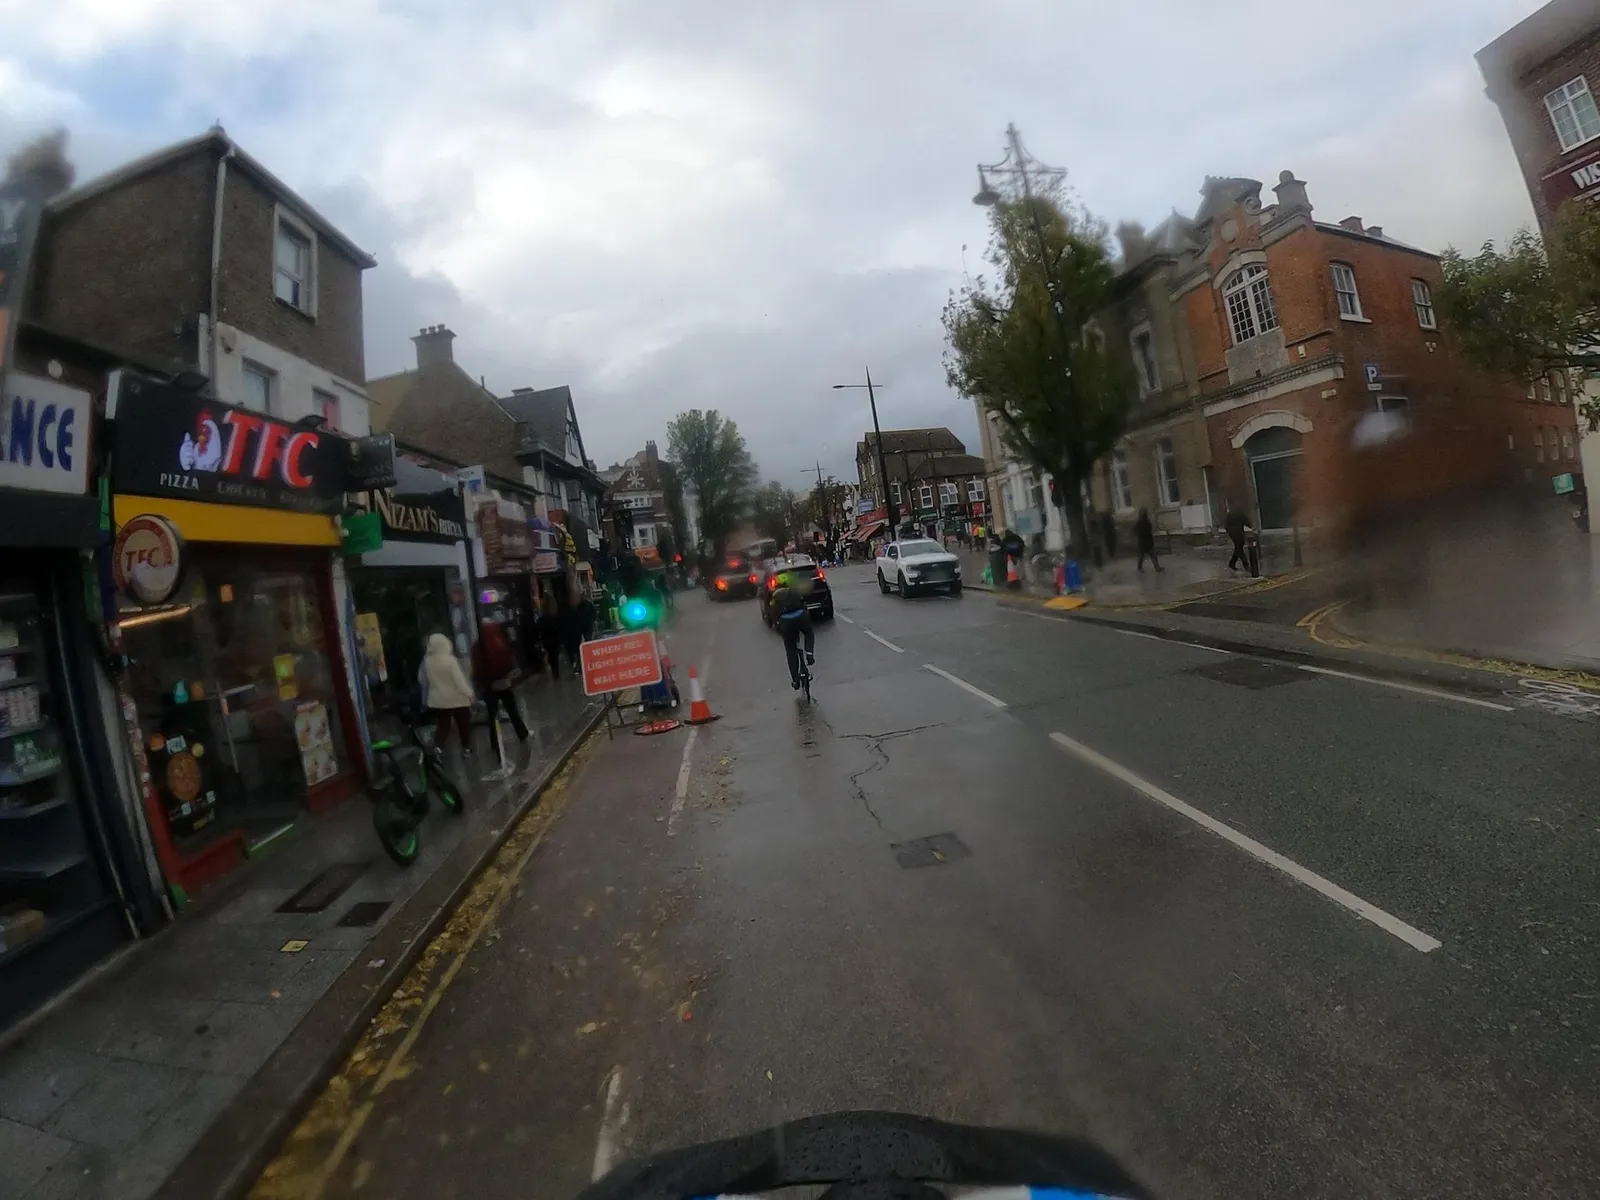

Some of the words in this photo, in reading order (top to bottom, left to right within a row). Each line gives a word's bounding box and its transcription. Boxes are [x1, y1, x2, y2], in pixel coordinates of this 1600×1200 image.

[1366, 366, 1378, 383] P
[0, 396, 75, 472] NCE
[222, 409, 320, 489] TFC
[159, 473, 200, 491] PIZZA
[592, 644, 621, 656] WHEN
[624, 640, 644, 649] RED
[588, 658, 616, 671] LIGHT
[617, 652, 652, 665] SHOWS
[593, 674, 616, 685] WAIT
[619, 666, 651, 680] HERE
